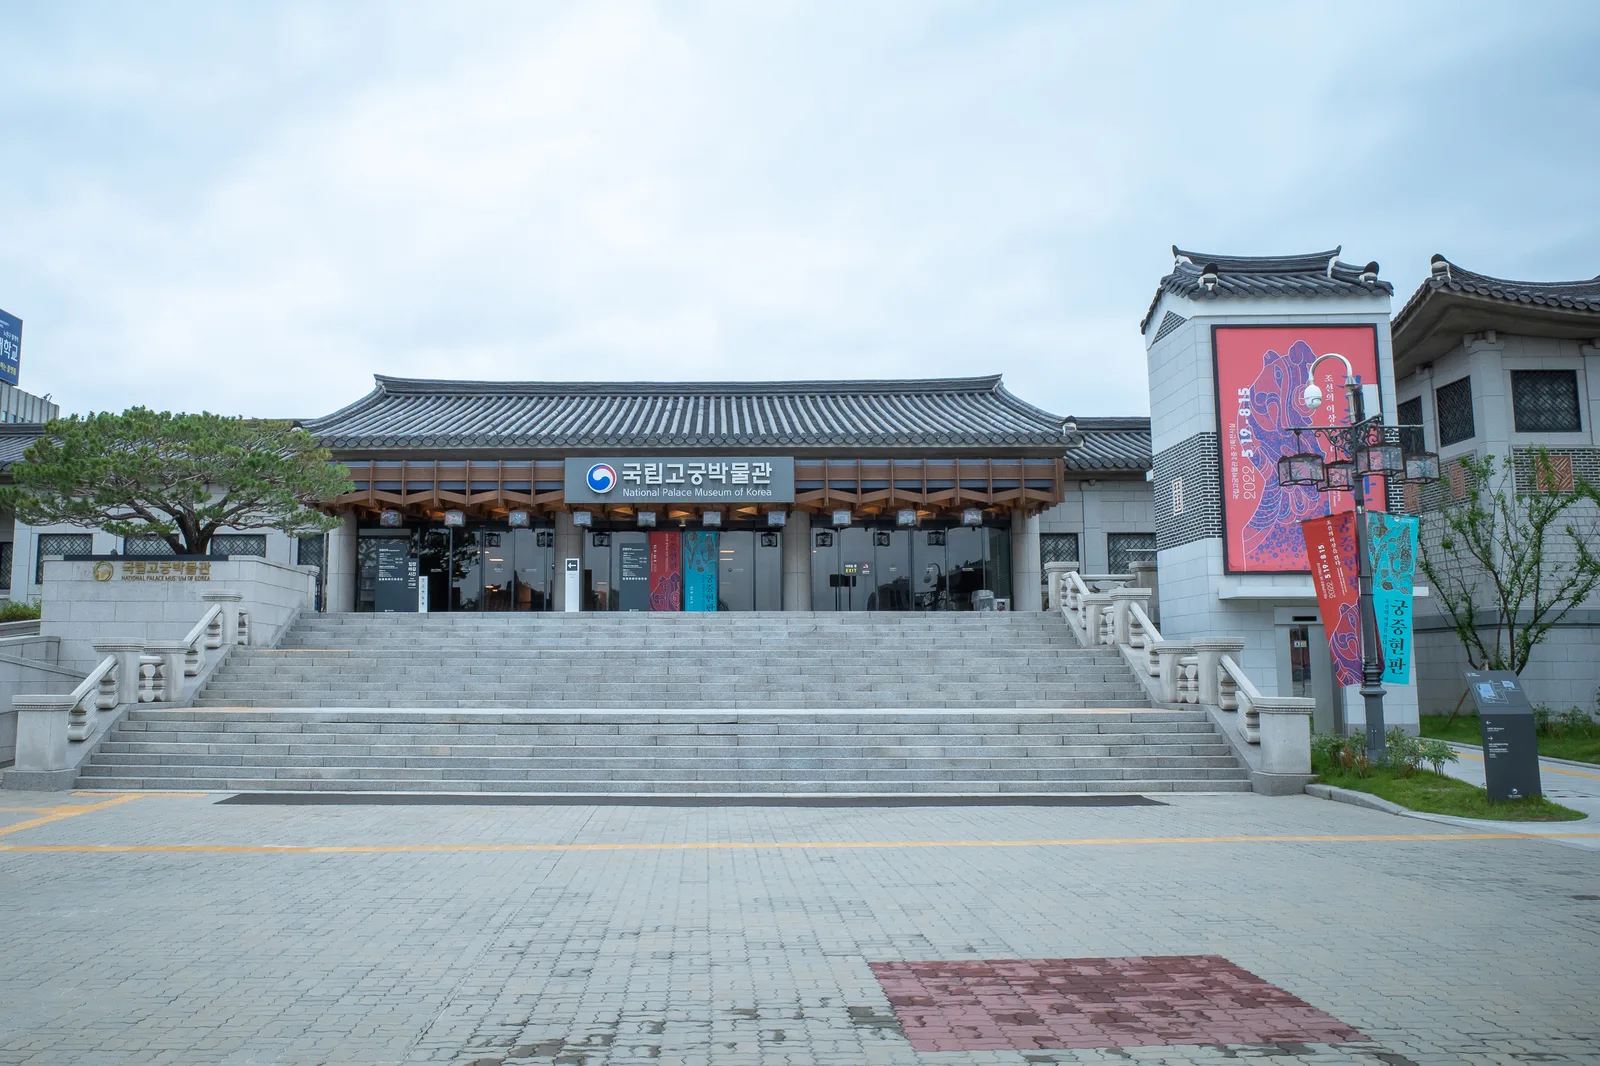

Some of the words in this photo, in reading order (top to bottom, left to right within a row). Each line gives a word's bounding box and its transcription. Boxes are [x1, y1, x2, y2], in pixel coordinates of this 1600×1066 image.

[1325, 374, 1334, 402] 조선의
[622, 462, 773, 486] 국립고궁박물관
[1231, 462, 1240, 500] 국립고궁박물관
[1242, 465, 1256, 500] 2022
[622, 487, 661, 497] National
[662, 488, 692, 497] Palace
[694, 488, 732, 497] Museum
[734, 487, 744, 497] of
[746, 488, 772, 497] Korea
[121, 561, 212, 576] 국립고궁박물관
[1388, 600, 1409, 675] 궁중현판
